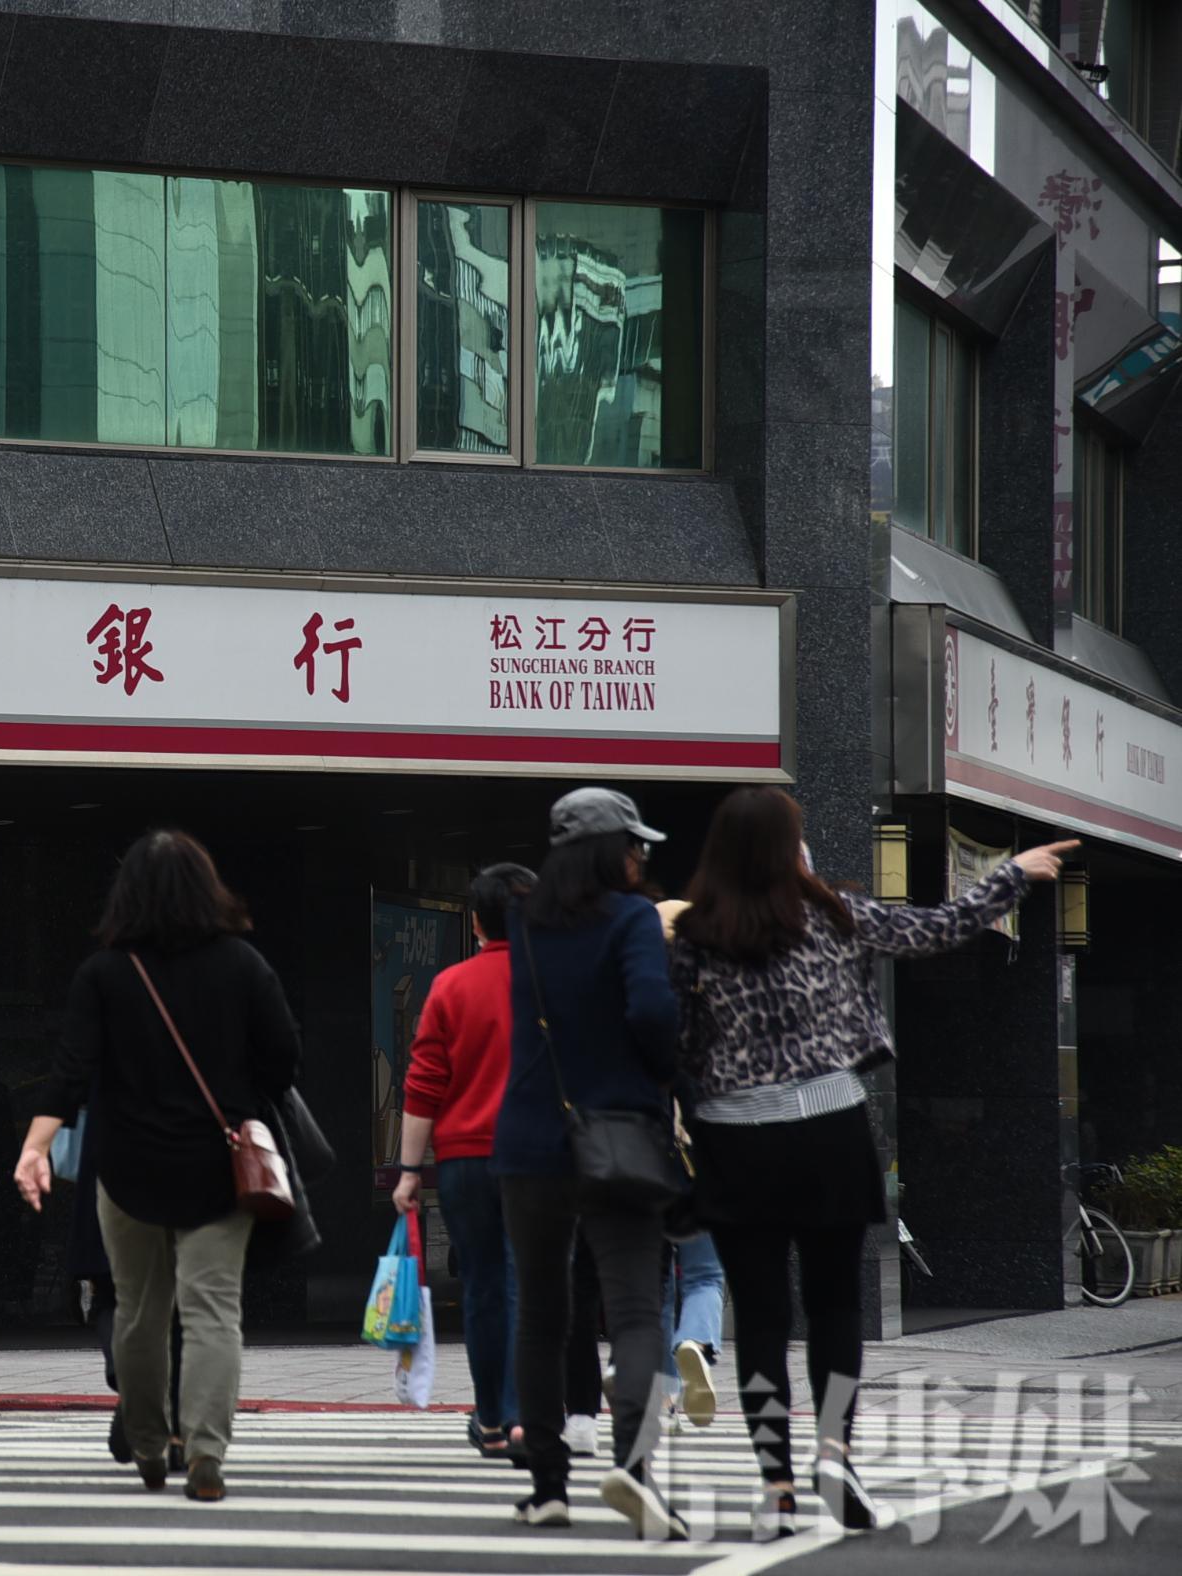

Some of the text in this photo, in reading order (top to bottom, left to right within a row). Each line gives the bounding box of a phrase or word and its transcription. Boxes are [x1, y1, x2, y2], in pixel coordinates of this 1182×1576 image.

[490, 614, 656, 652] 松江分行
[490, 658, 655, 676] SUNGCHIANG BRANCH
[490, 680, 655, 711] BANK OF TAIWAN
